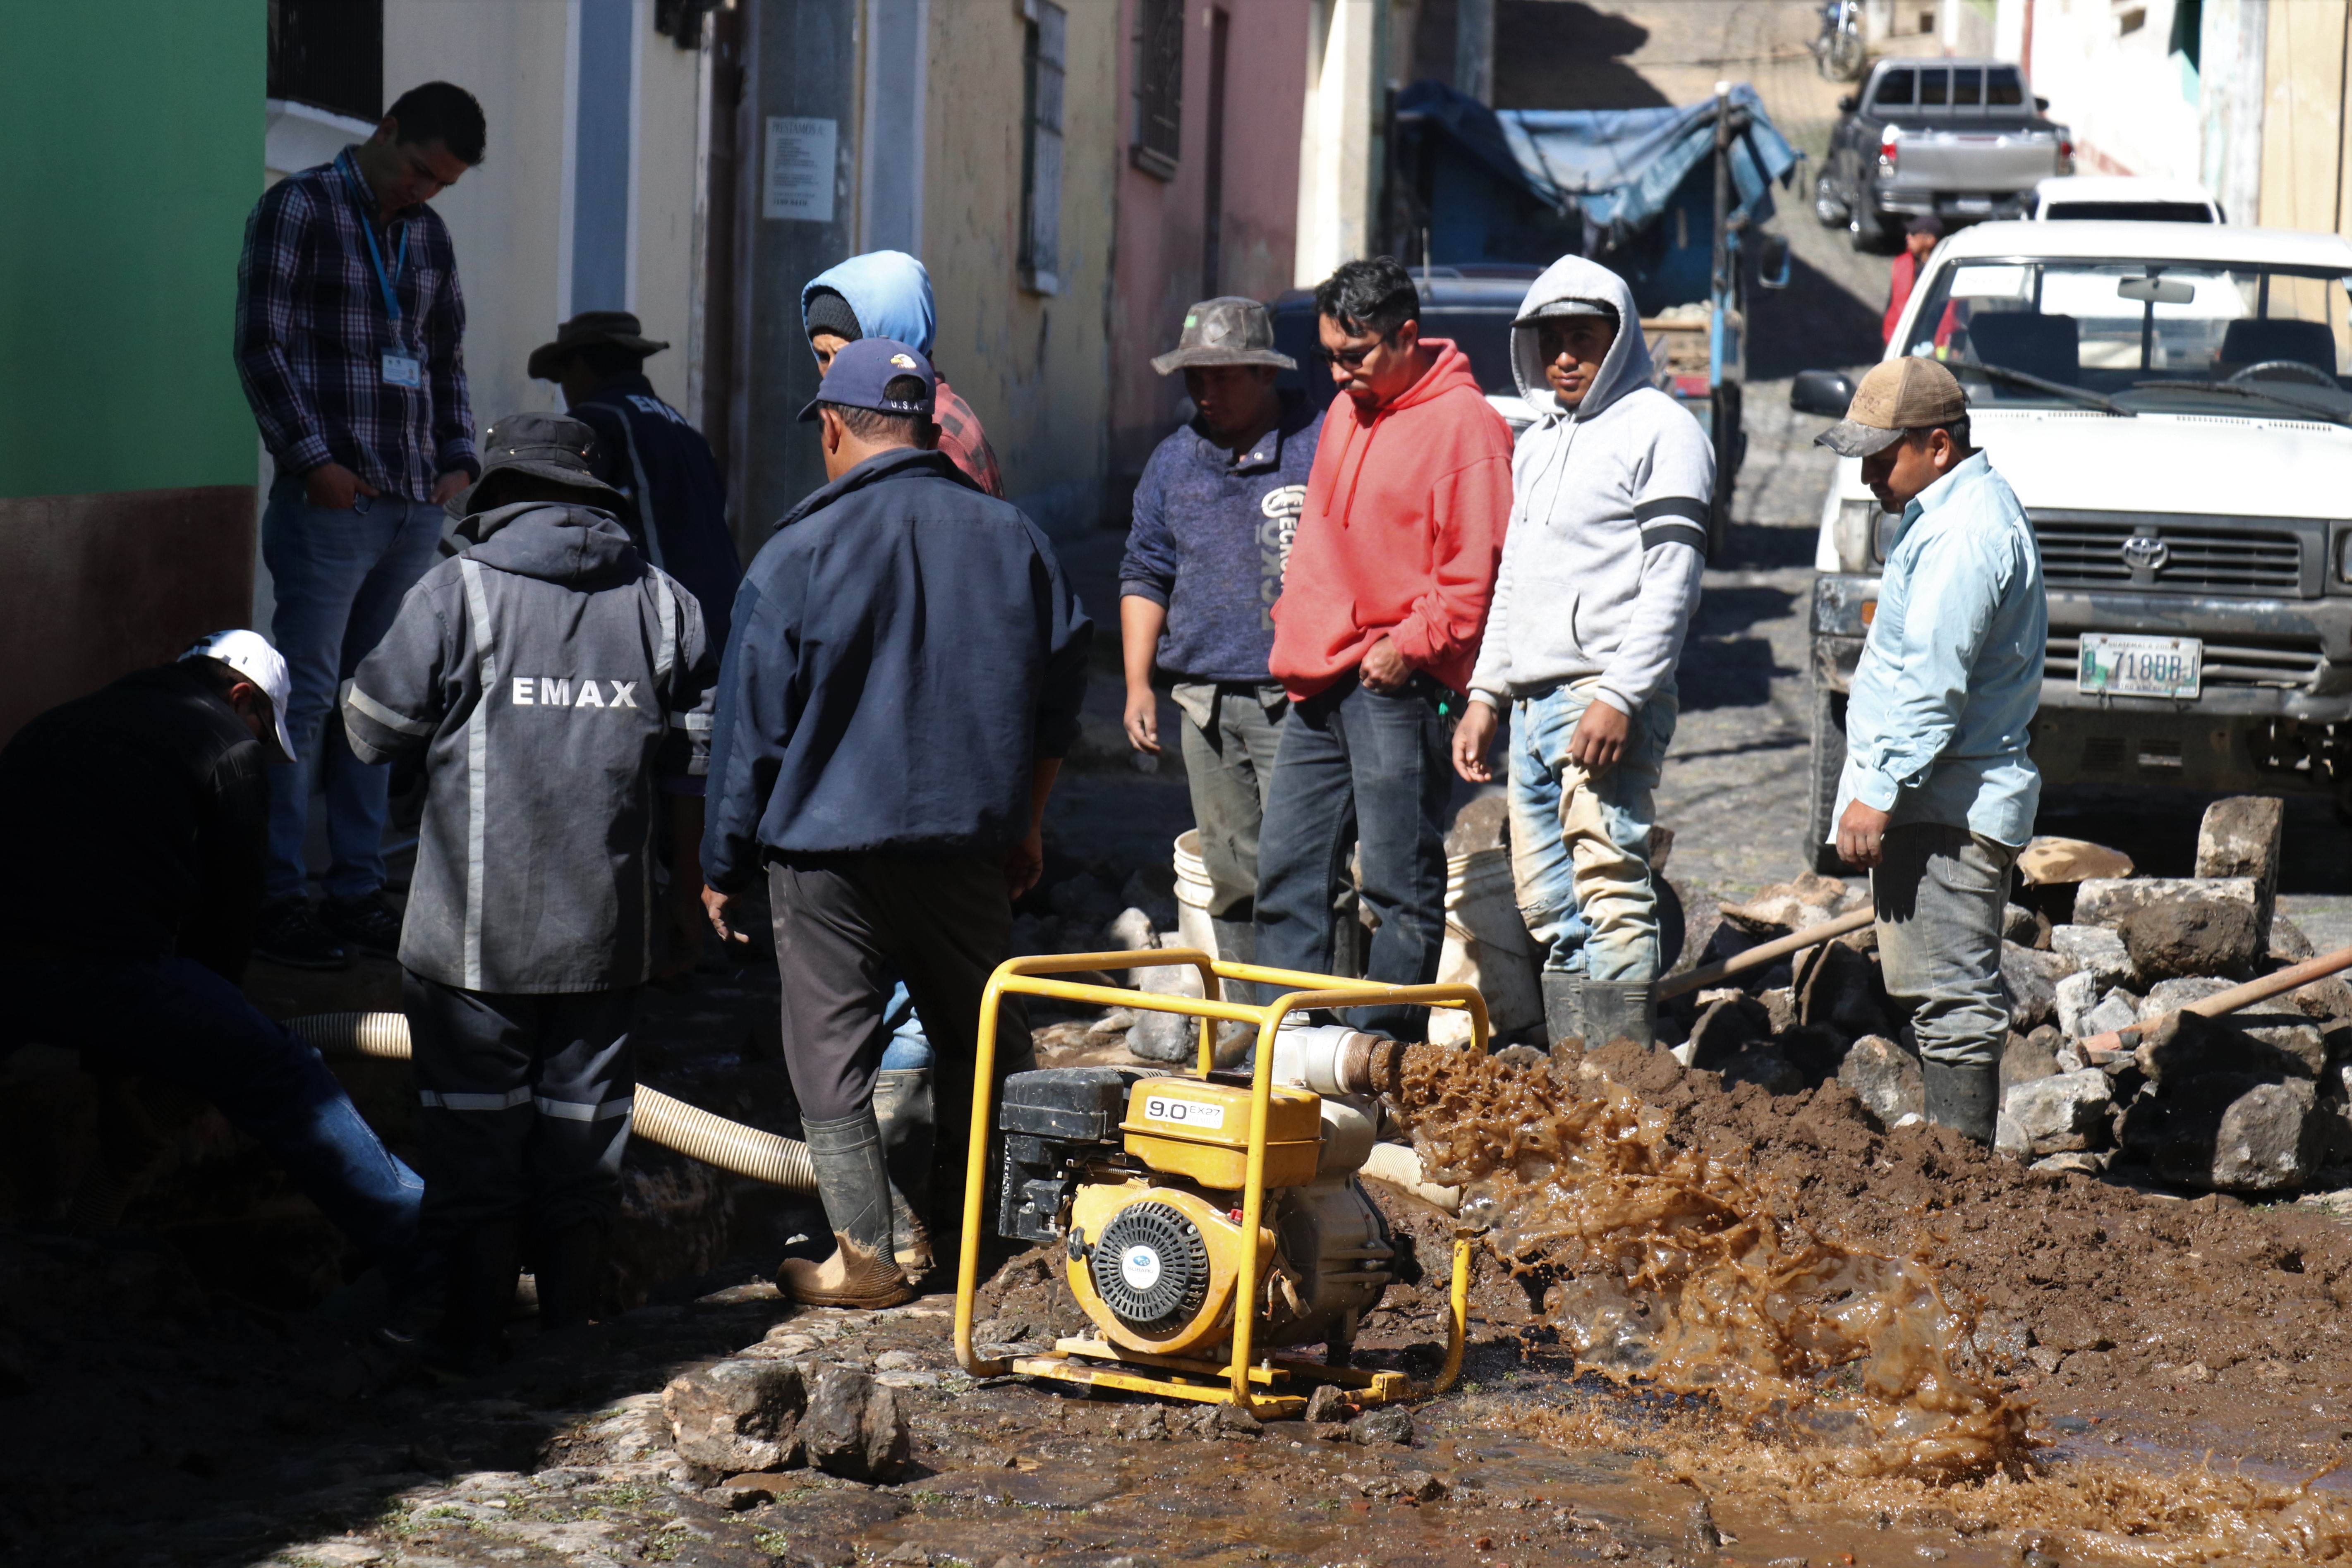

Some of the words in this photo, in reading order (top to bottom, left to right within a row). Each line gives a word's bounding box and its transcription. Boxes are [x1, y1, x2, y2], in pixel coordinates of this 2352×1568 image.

[512, 677, 639, 708] EMAX
[1149, 1101, 1187, 1120] 9.0
[1190, 1106, 1220, 1116] EX27
